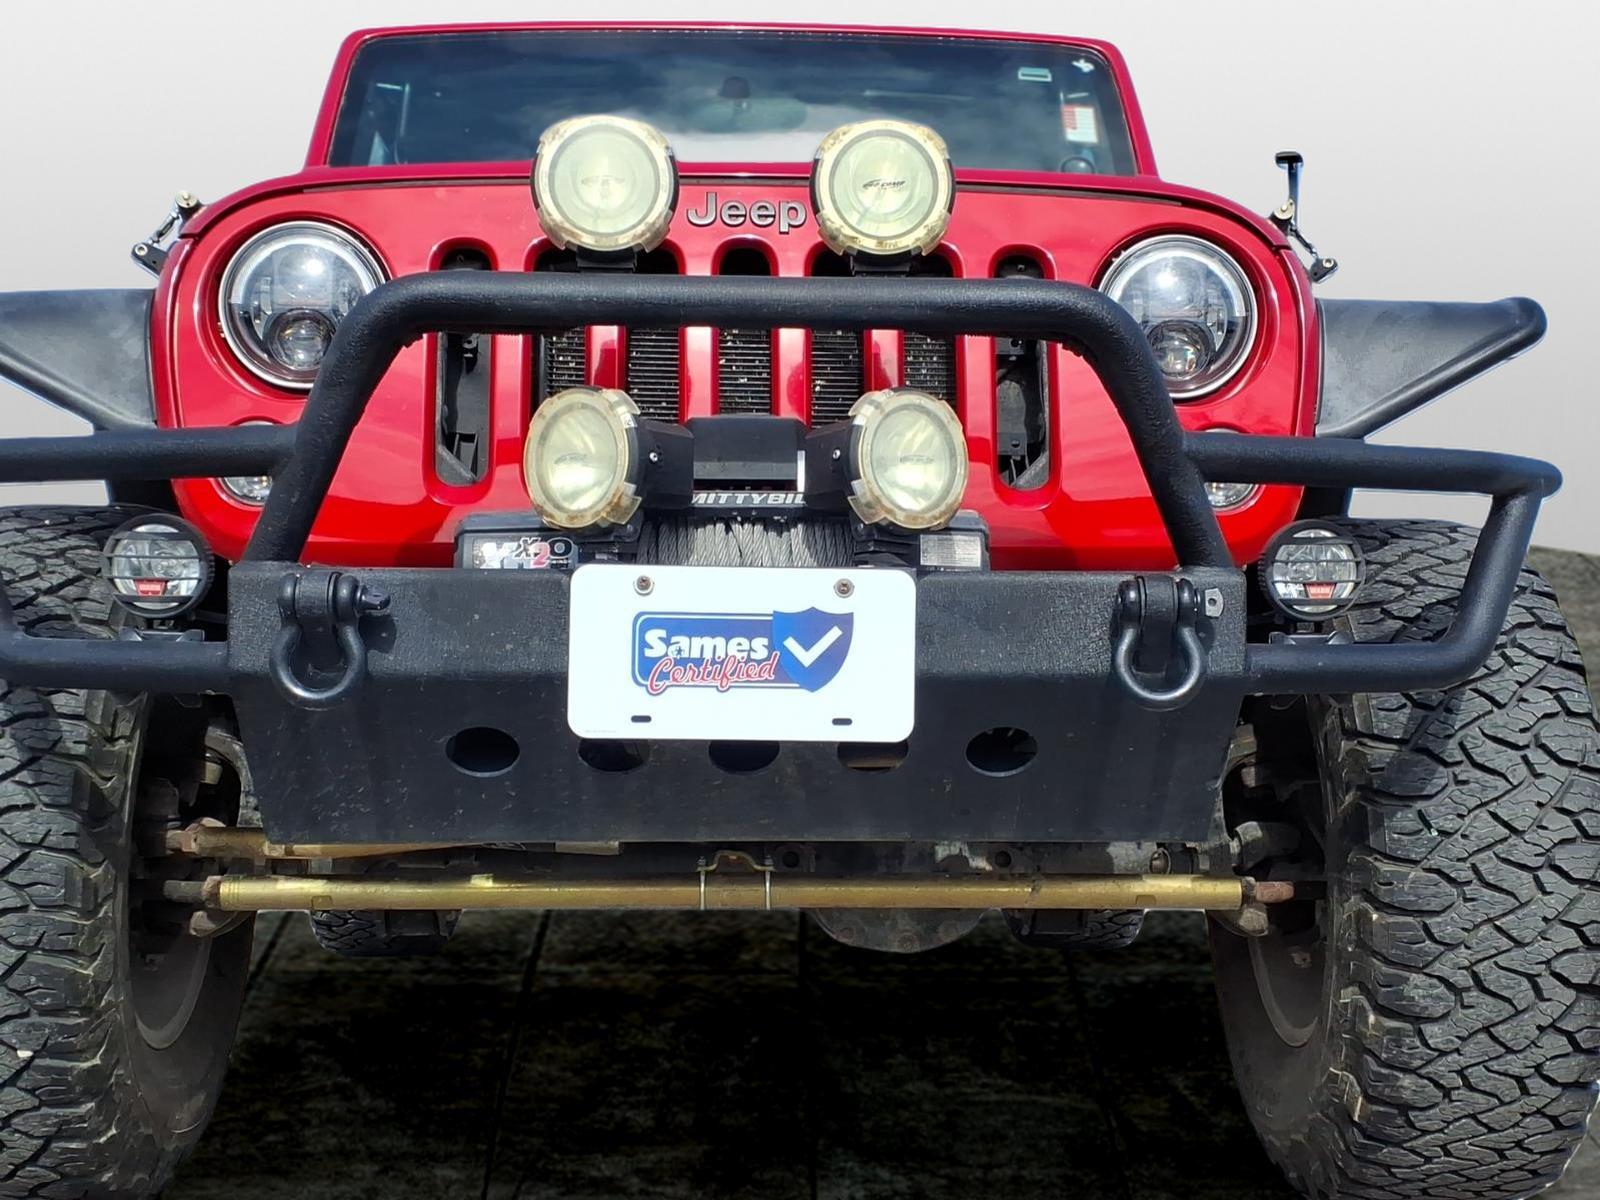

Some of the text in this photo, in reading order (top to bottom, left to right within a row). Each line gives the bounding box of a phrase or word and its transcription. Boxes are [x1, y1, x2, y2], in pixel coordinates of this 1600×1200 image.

[687, 192, 807, 234] Jeep
[644, 629, 769, 660] Sames
[648, 651, 780, 693] Certified
